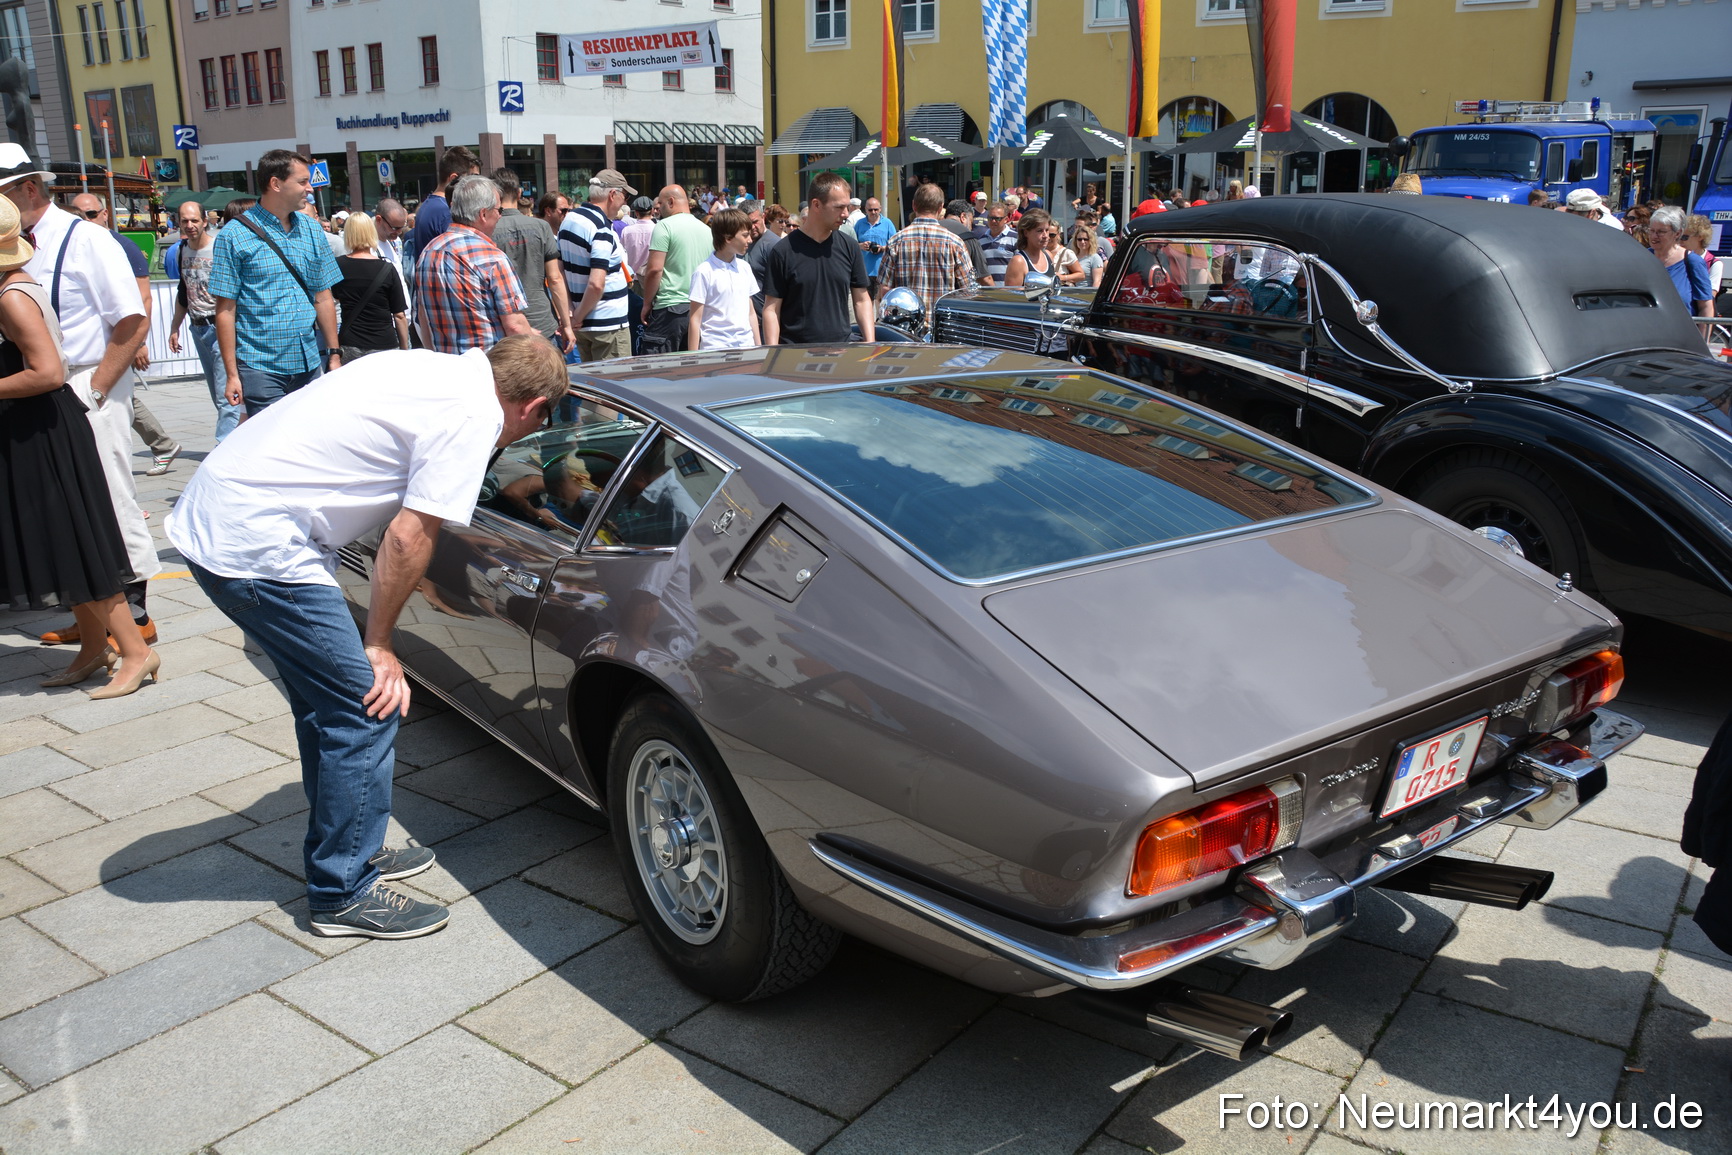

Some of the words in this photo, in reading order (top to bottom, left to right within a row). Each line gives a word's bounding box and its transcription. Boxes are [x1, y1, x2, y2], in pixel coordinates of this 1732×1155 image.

[583, 31, 699, 55] RESIDENZPLATZ
[611, 54, 678, 67] Sonderschauen
[336, 113, 399, 129] Buchhandlung
[401, 109, 450, 127] Rupprecht
[1454, 133, 1467, 141] NM
[1469, 133, 1490, 141] 24/53
[1423, 740, 1441, 770] R
[1404, 758, 1461, 803] 0715
